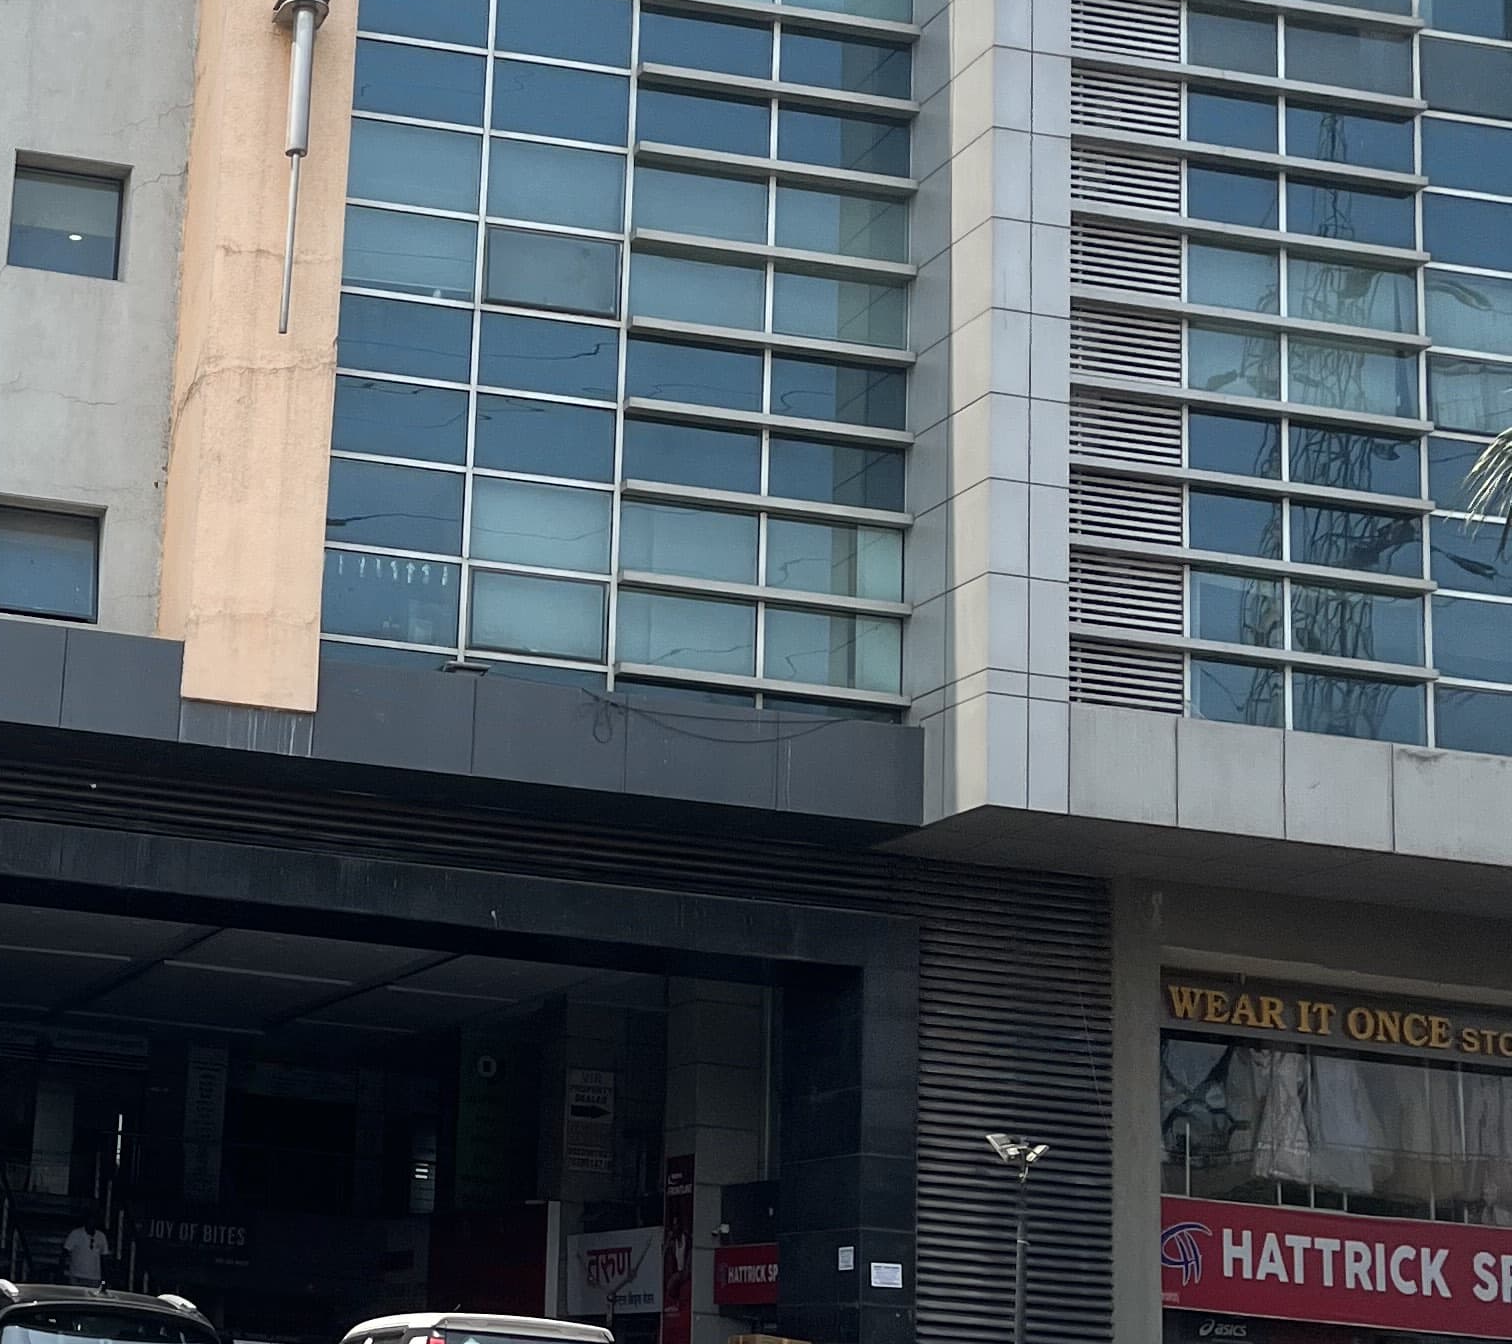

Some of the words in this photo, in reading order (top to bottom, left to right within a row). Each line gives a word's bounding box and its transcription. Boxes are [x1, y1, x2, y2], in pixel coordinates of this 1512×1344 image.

[1168, 984, 1287, 1030] WEAR
[1296, 1000, 1337, 1035] IT
[1347, 1006, 1454, 1049] ONCE
[148, 1218, 173, 1239] JOY
[179, 1221, 199, 1240] OF
[203, 1224, 247, 1246] BITES
[728, 1263, 767, 1284] HATTRICK
[1222, 1227, 1453, 1298] HATTRICK
[1214, 1321, 1247, 1338] asics
